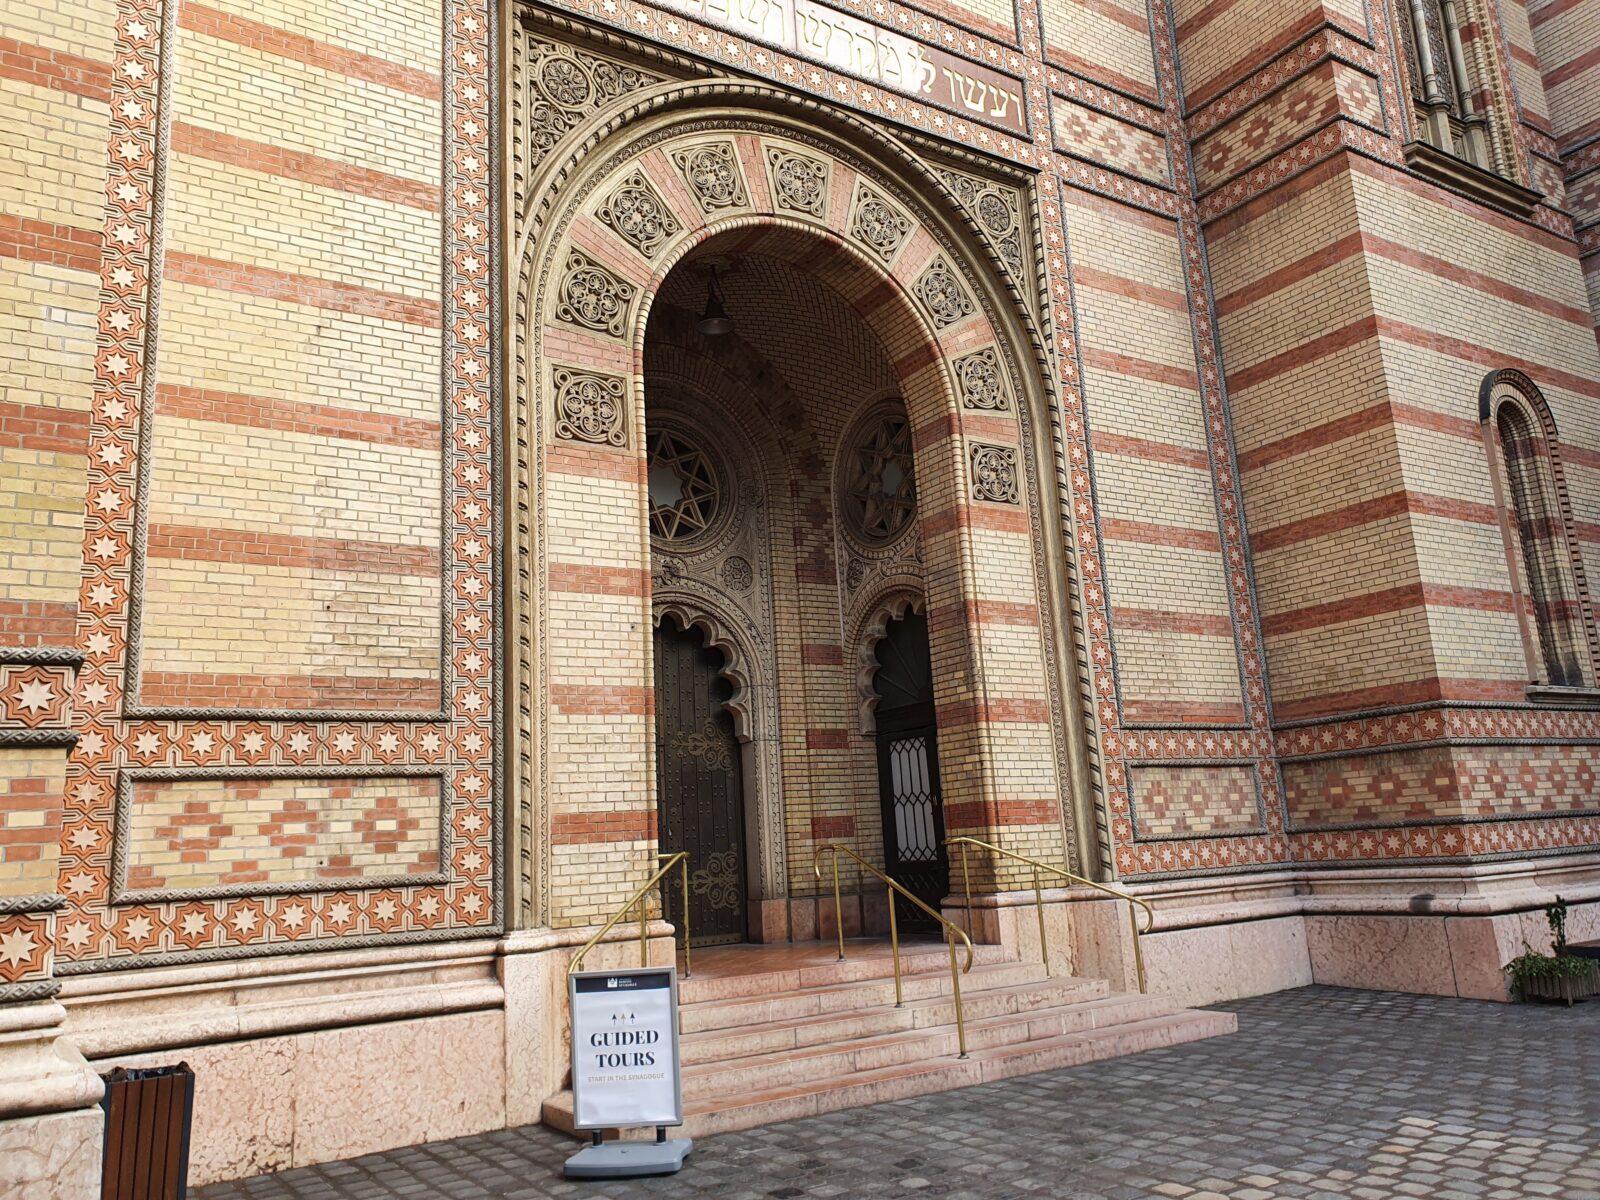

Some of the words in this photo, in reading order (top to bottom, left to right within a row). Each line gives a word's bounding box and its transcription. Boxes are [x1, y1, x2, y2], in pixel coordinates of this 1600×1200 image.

[590, 1030, 659, 1047] GUIDED
[595, 1051, 655, 1068] TOURS
[628, 1072, 665, 1080] SYNAGOGUE
